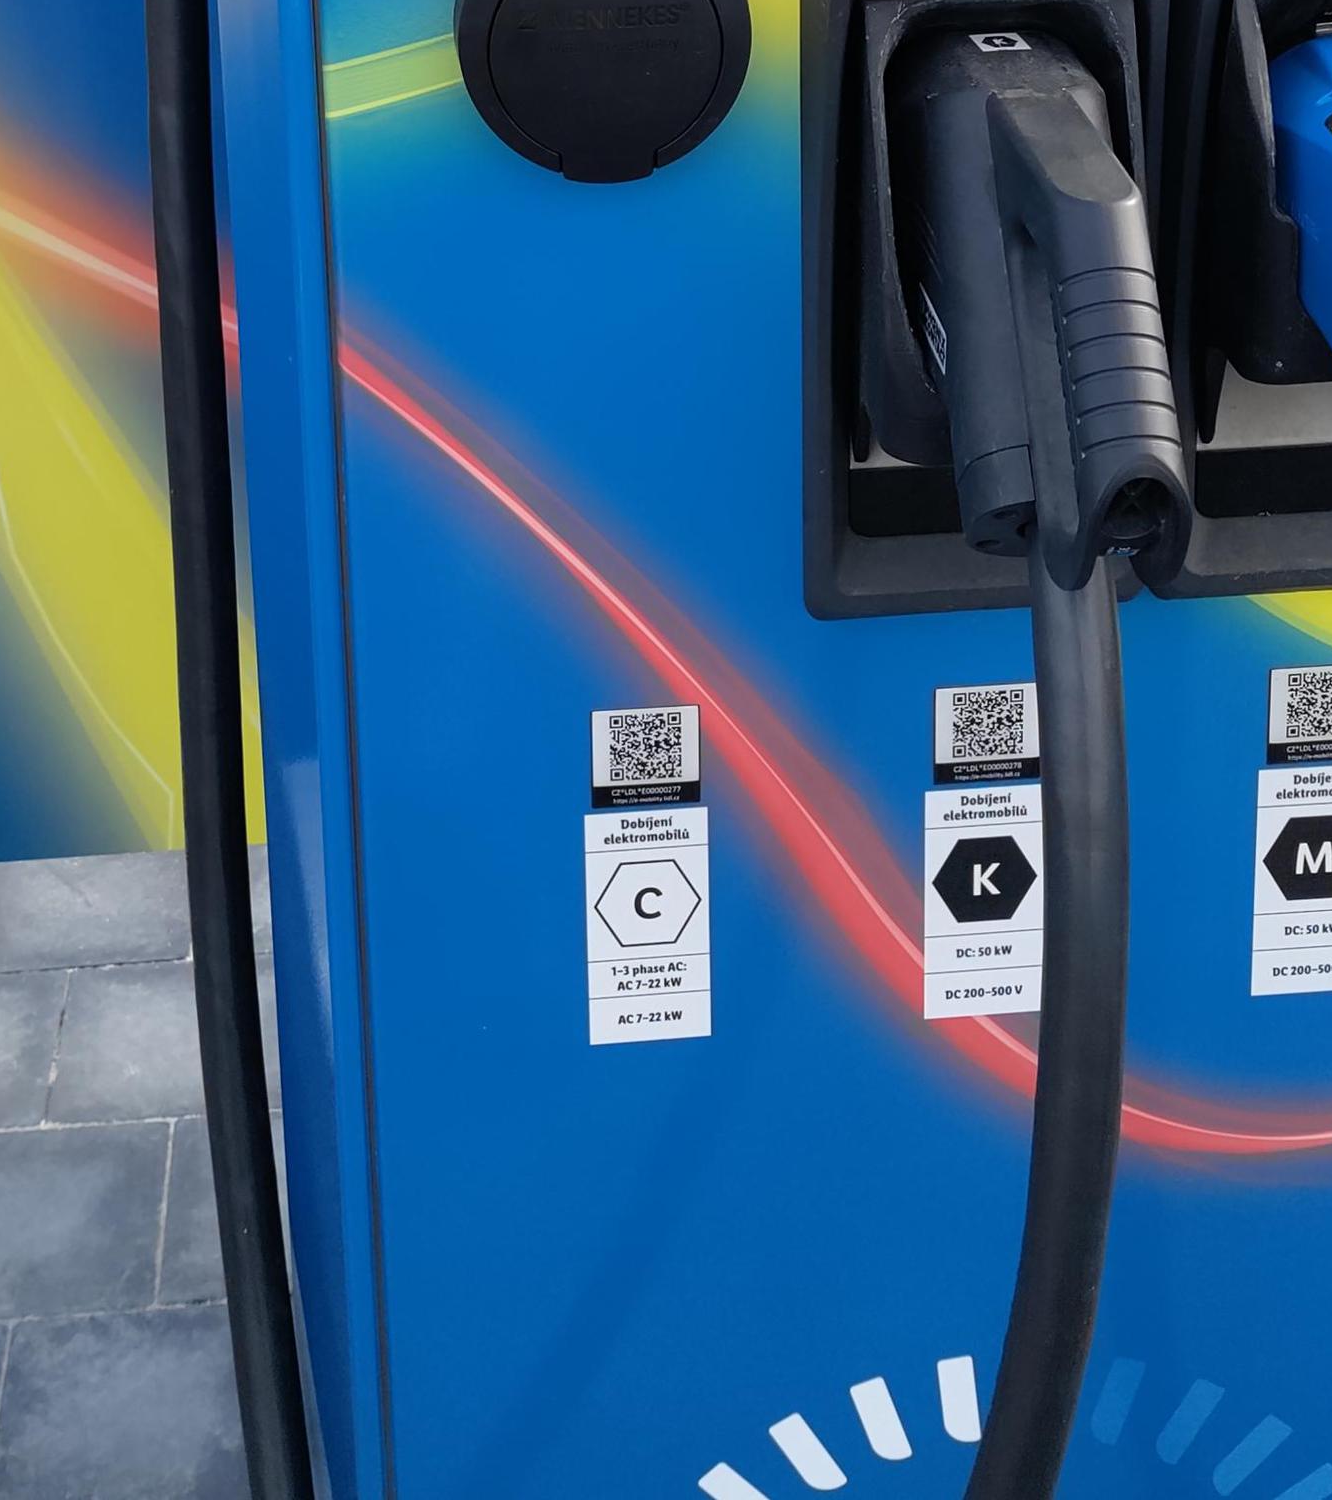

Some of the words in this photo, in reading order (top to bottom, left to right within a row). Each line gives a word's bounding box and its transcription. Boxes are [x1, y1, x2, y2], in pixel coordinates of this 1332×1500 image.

[960, 793, 1012, 807] Dobíjení
[943, 805, 1028, 821] elektromobilů
[620, 816, 673, 831] Dobíjení
[603, 828, 690, 845] elektromobilů
[972, 862, 1002, 897] K
[634, 887, 663, 920] C
[1284, 926, 1304, 936] DC:
[1306, 924, 1320, 935] 50
[956, 949, 976, 959] DC:
[978, 947, 992, 957] 50
[994, 945, 1013, 956] kW
[632, 964, 665, 977] phase
[667, 961, 687, 972] AC:
[1272, 967, 1289, 977] DC
[617, 980, 634, 991] AC
[663, 976, 682, 988] kW
[945, 990, 962, 1000] DC
[1014, 985, 1023, 995] V
[617, 1015, 634, 1025] AC
[664, 1010, 682, 1021] kW
